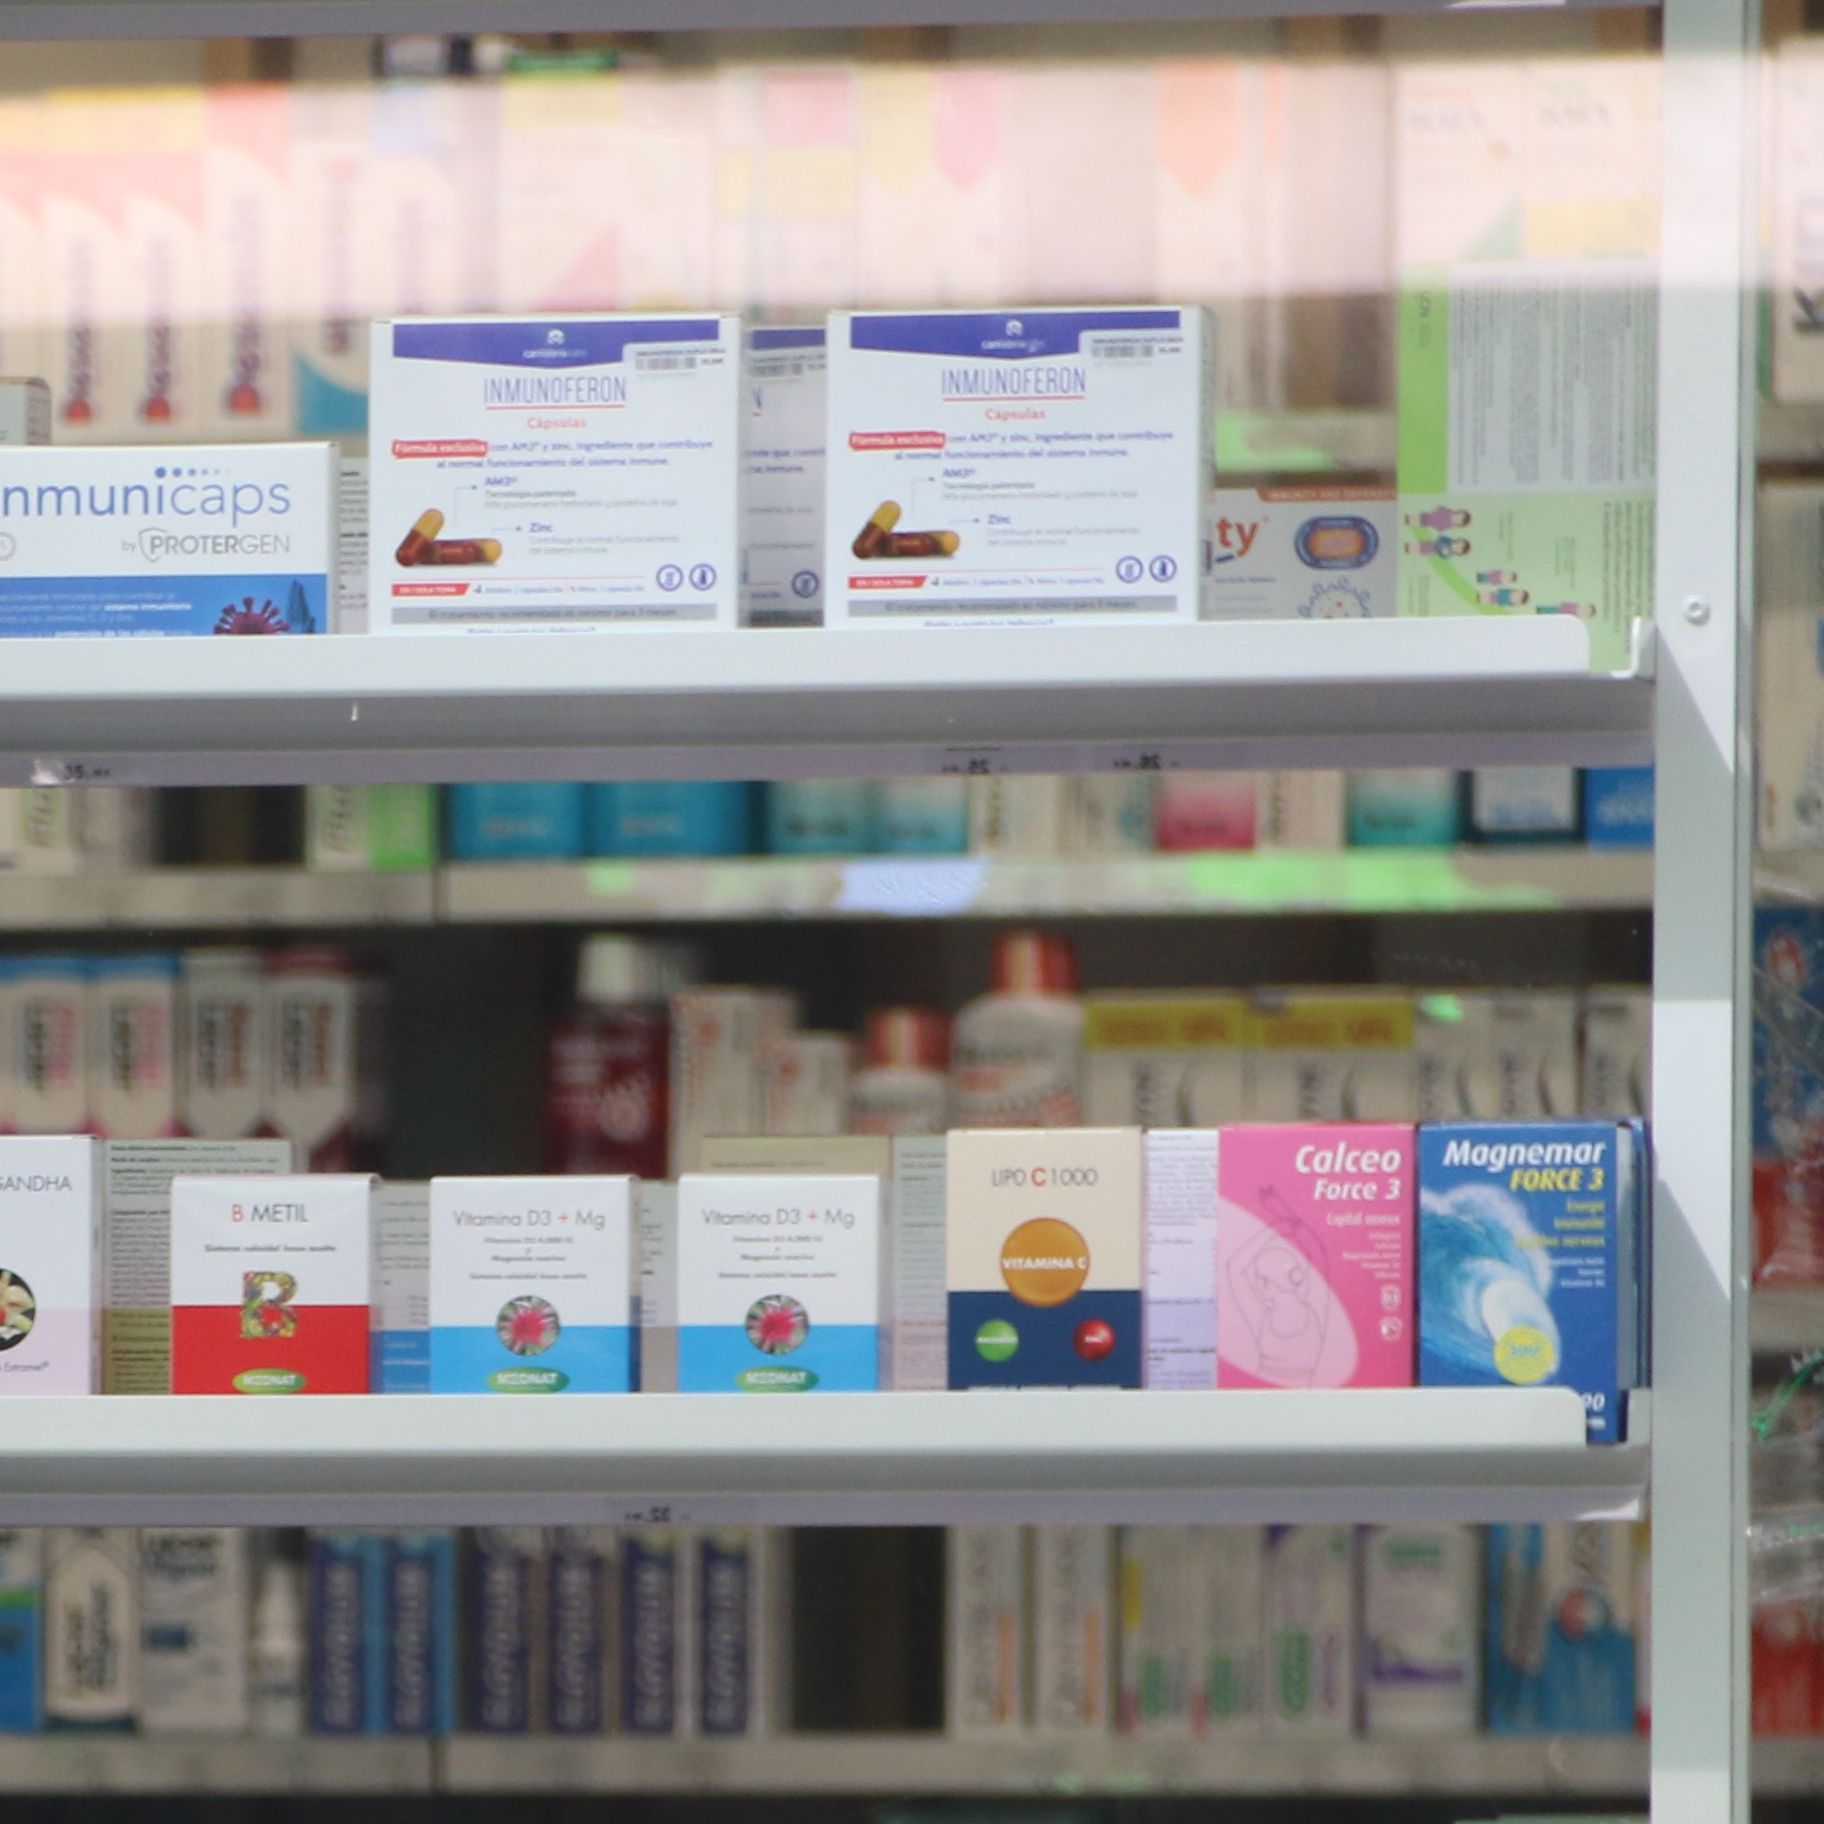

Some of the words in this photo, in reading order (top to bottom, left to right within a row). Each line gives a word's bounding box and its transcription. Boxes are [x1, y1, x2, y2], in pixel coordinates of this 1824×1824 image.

[484, 376, 628, 404] INMUNOFERON
[942, 367, 1087, 395] INMUNOFERON
[121, 540, 137, 554] by
[150, 534, 291, 555] PROTERGEN
[1295, 1141, 1402, 1175] Calceo
[1442, 1139, 1605, 1173] Magnemar
[991, 1168, 1026, 1187] LIPO
[1030, 1168, 1047, 1187] C
[1051, 1168, 1098, 1187] 1000
[1508, 1168, 1584, 1192] FORCE
[1589, 1168, 1605, 1191] 3
[1314, 1179, 1378, 1200] Force
[1385, 1179, 1402, 1199] 3
[232, 1204, 244, 1223] B
[251, 1204, 309, 1223] METIL
[453, 1210, 521, 1226] Vitamina
[526, 1210, 551, 1226] D3
[574, 1210, 606, 1229] Mg
[1002, 1257, 1071, 1269] VITAMINA
